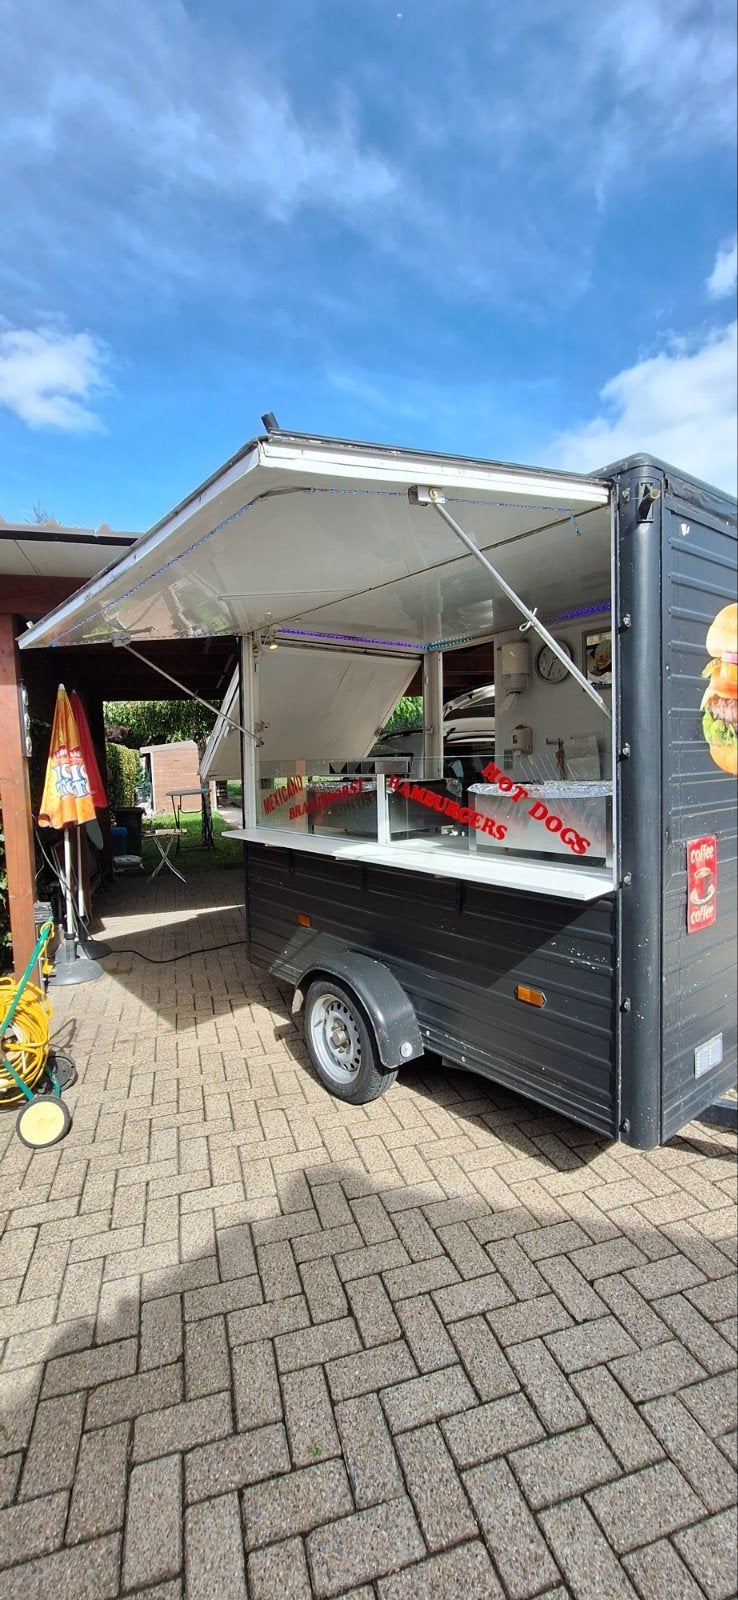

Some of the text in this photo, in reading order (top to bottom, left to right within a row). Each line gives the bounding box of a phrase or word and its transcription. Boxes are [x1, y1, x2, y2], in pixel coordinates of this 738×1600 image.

[262, 774, 303, 816] MEXICANO
[388, 774, 508, 841] HAMBURGERS
[480, 761, 592, 855] HOT DOGS
[690, 843, 715, 865] coffee
[690, 904, 715, 925] coffee
